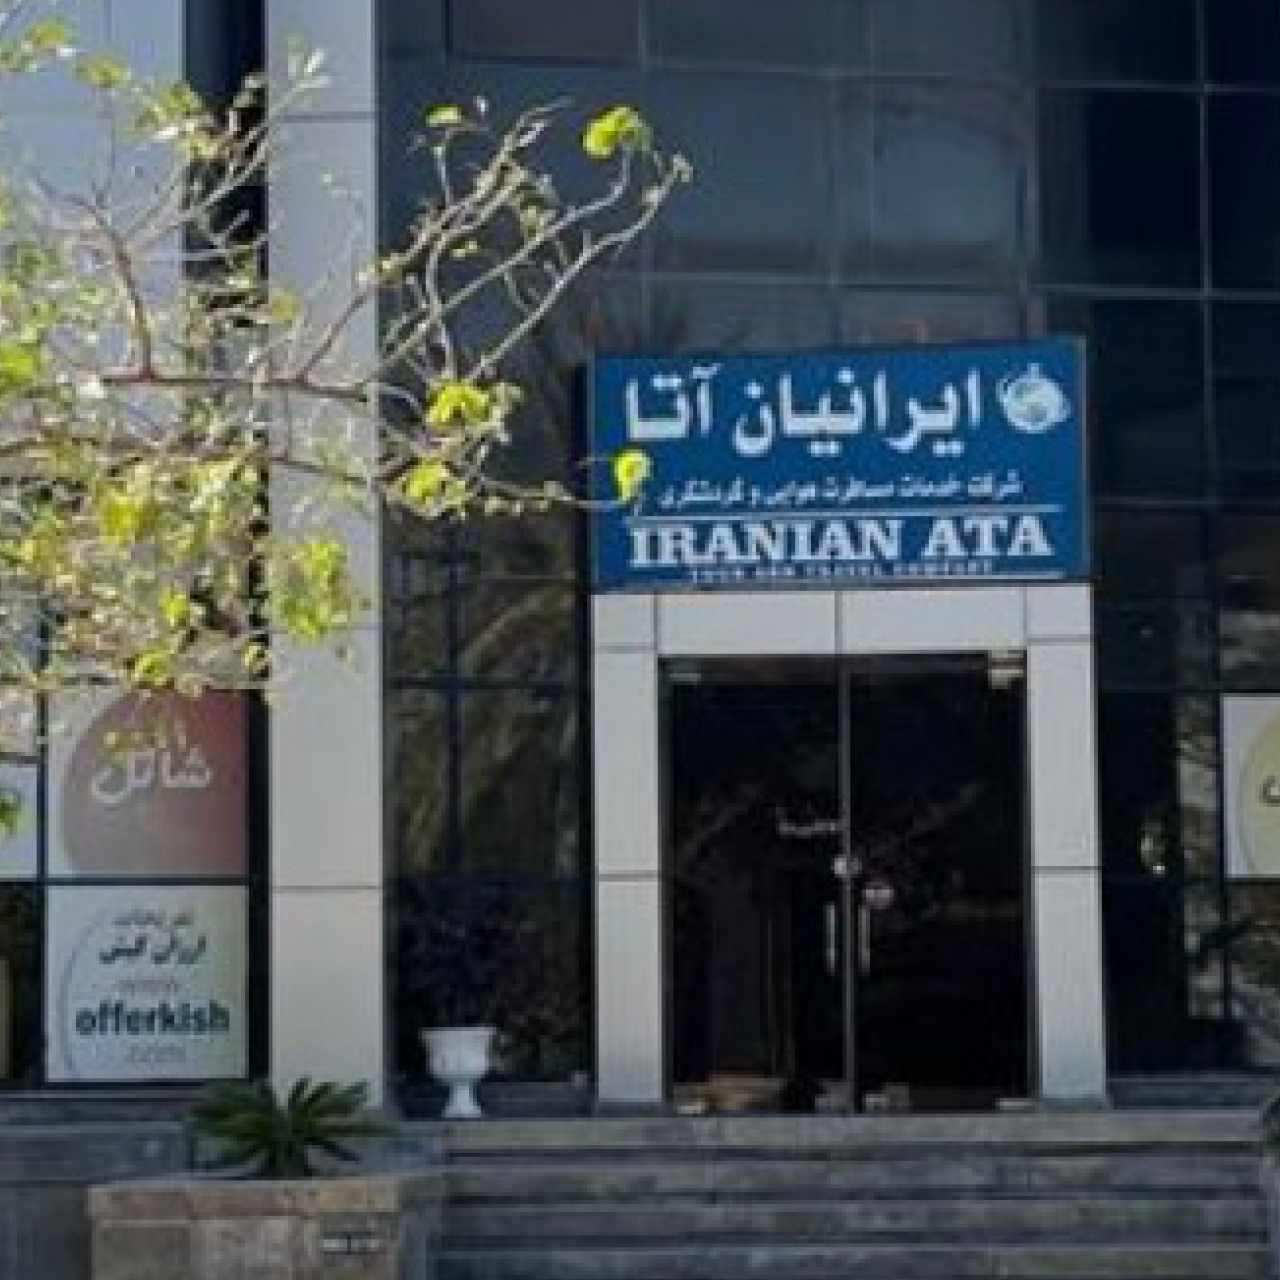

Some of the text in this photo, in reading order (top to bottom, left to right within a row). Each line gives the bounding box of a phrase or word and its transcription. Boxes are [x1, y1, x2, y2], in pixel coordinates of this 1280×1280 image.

[625, 363, 982, 457] ایرانیان آتا
[630, 515, 1055, 568] IRANIAN ATA
[75, 999, 230, 1036] offerkish
